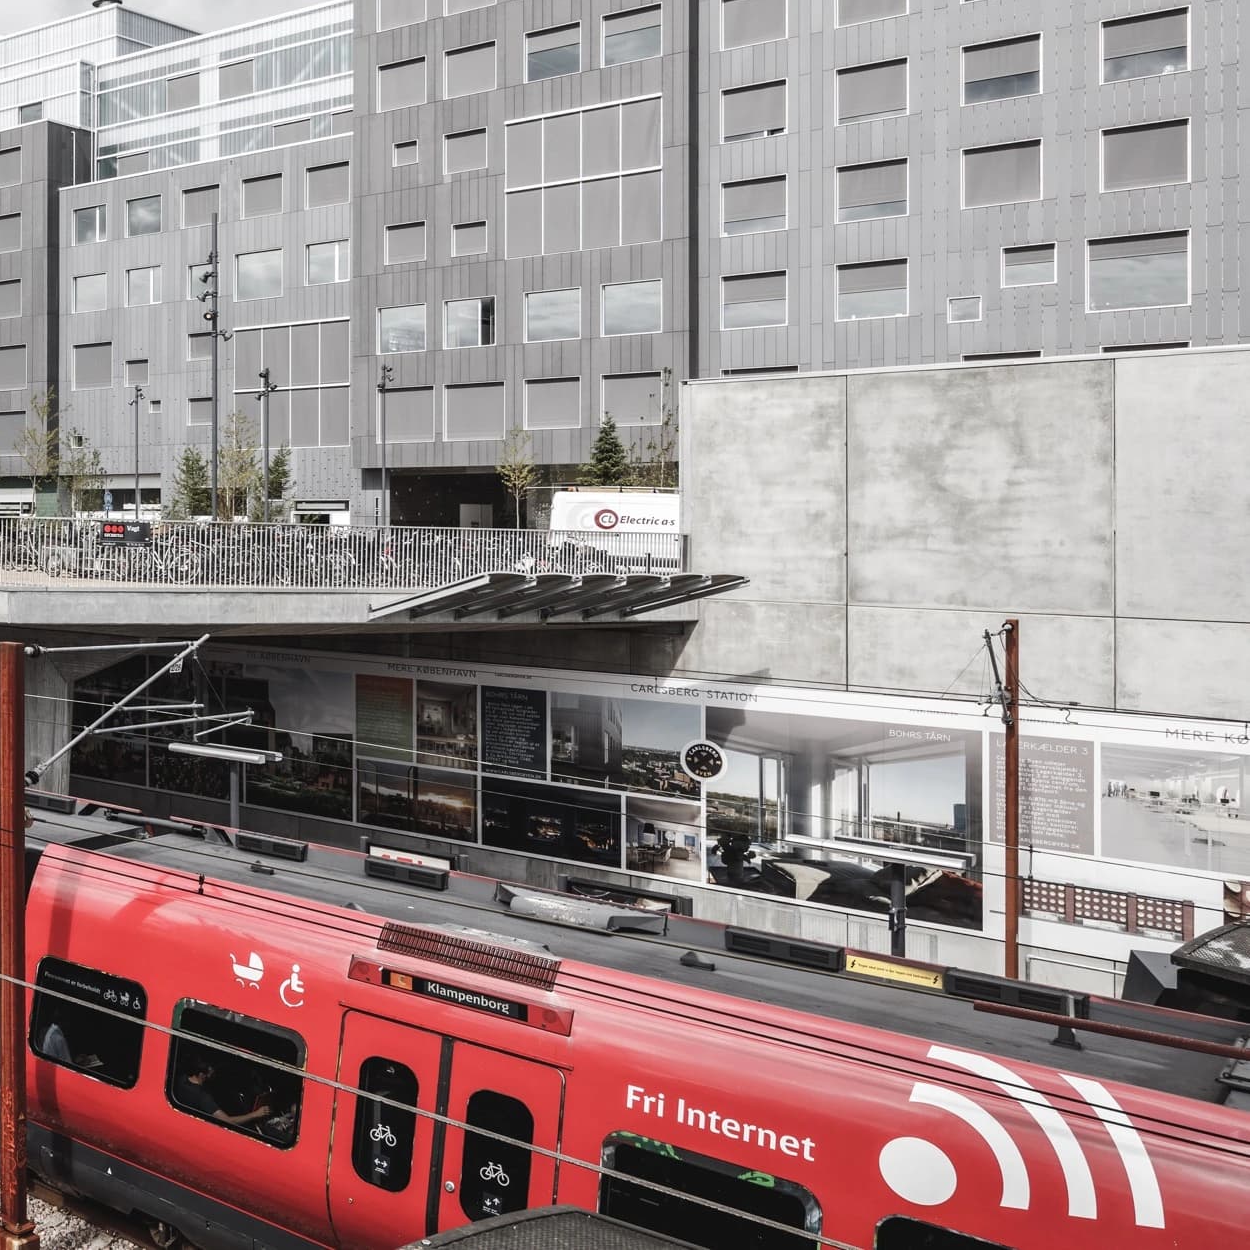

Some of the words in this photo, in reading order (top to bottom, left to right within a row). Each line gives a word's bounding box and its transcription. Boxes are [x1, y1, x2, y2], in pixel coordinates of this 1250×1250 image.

[601, 515, 614, 524] CL
[620, 515, 660, 526] Electric
[387, 662, 414, 673] MERE
[416, 665, 477, 679] KØBENHAVN
[631, 683, 700, 698] CARLSBERG
[707, 690, 758, 703] STATION
[889, 728, 922, 739] BOHRS
[925, 730, 951, 742] TÅRN
[1165, 727, 1215, 742] MERE
[996, 738, 1078, 755] LERKÆLDER
[1081, 747, 1089, 756] 3
[427, 981, 510, 1014] Klampenborg
[626, 1084, 665, 1118] Fri
[676, 1098, 816, 1162] Internet
